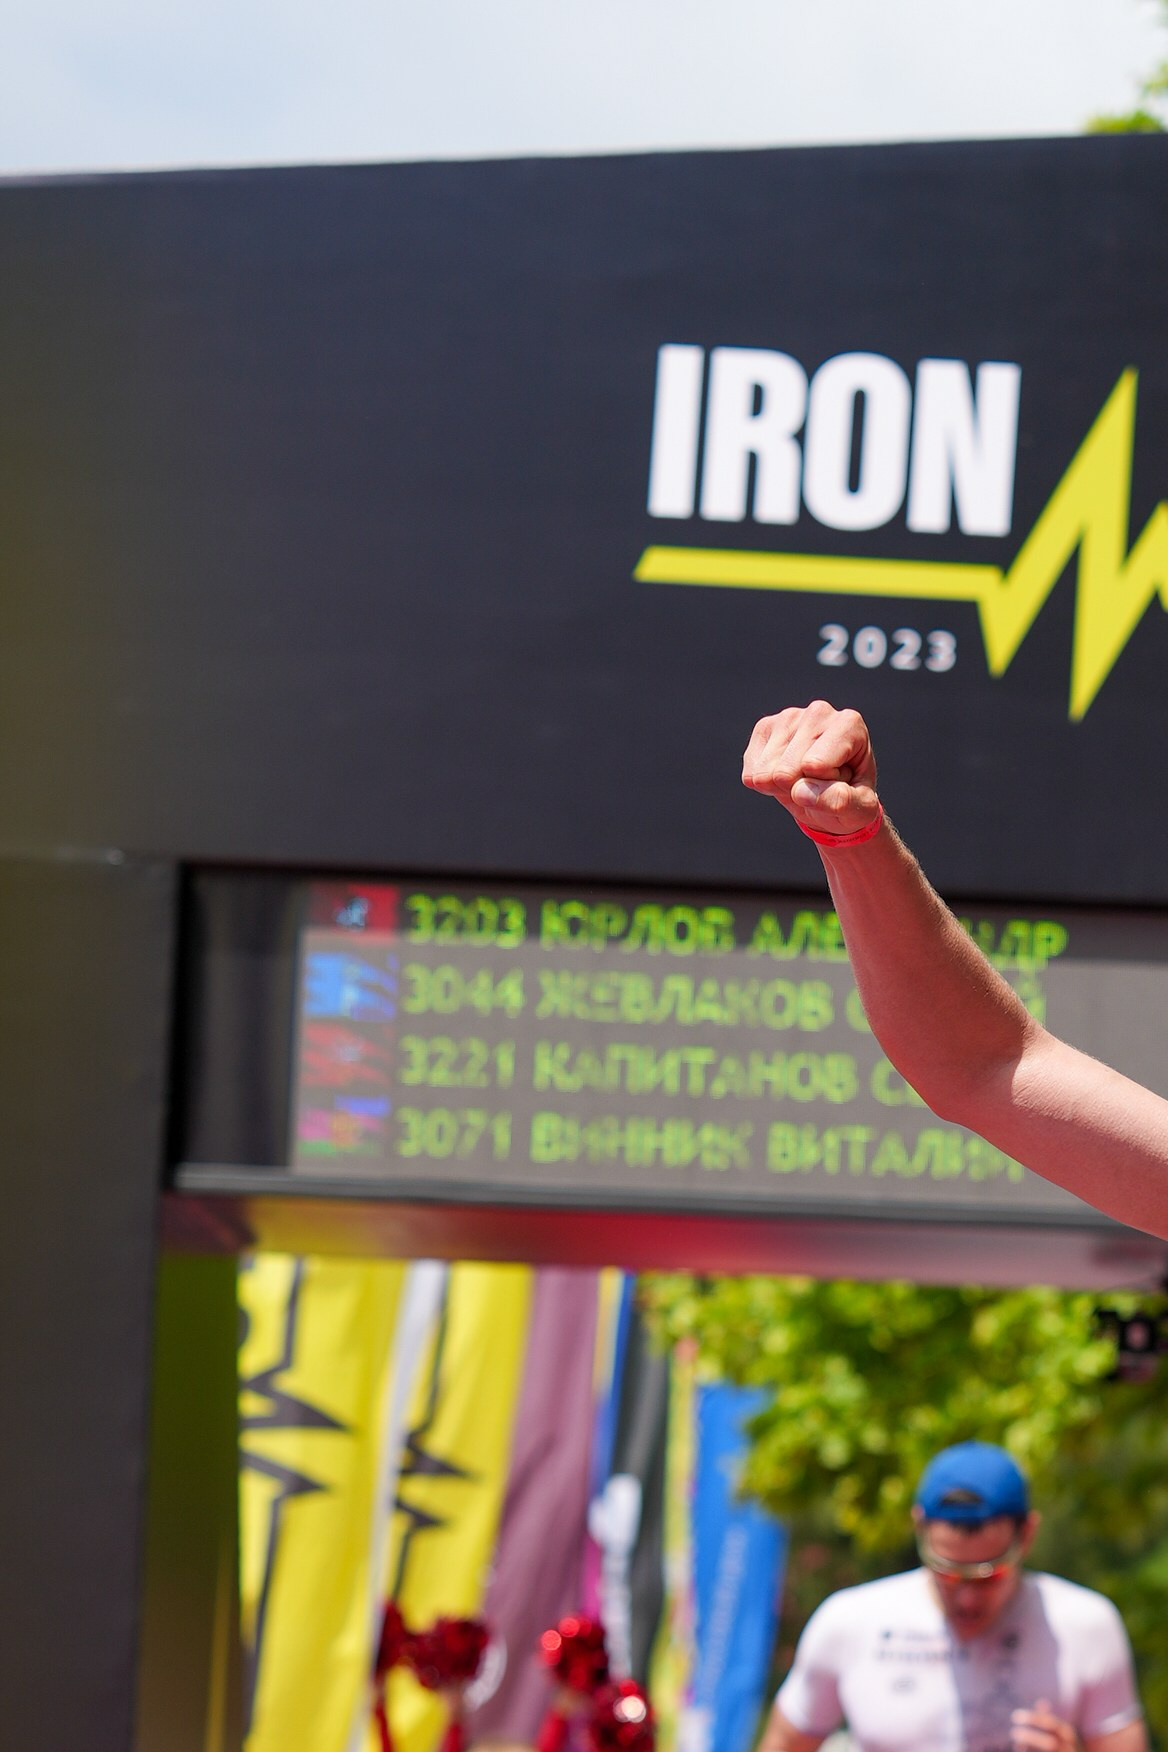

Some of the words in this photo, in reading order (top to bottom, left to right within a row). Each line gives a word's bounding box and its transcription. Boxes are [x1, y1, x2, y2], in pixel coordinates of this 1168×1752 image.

[646, 342, 1023, 538] IRON
[817, 622, 958, 673] 2023
[404, 893, 525, 950] 3203
[402, 962, 525, 1019] 3044
[400, 1033, 517, 1089] 3221
[532, 1040, 859, 1104] КАПИТАНОВ
[395, 1106, 513, 1162] 3071
